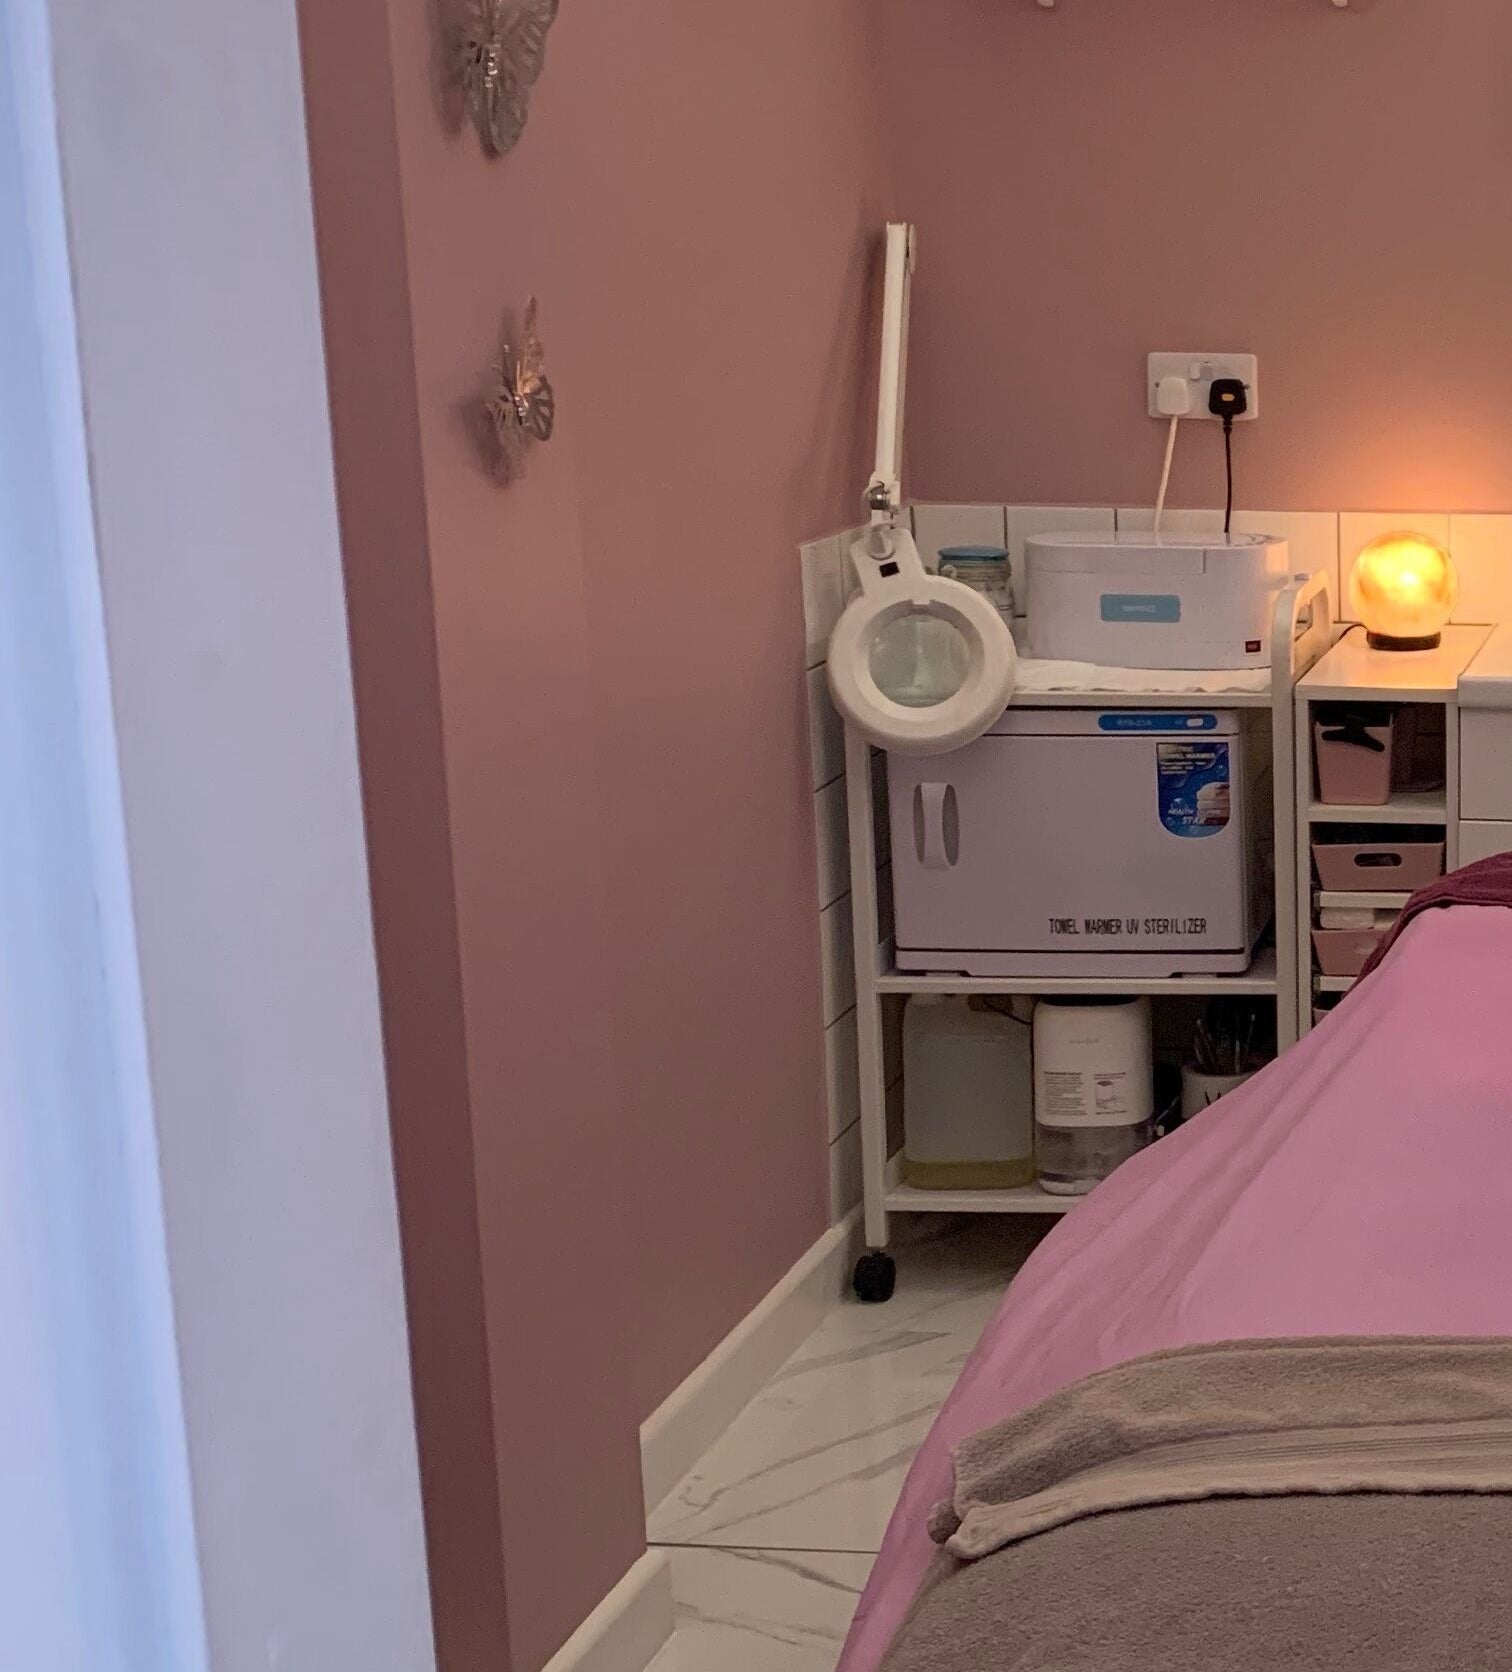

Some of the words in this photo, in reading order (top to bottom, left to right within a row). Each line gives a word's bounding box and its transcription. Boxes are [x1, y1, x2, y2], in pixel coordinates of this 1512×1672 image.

[1049, 918, 1080, 934] TOWEL
[1084, 918, 1122, 934] WARMER
[1126, 918, 1139, 934] UV
[1144, 918, 1207, 934] STERILIZER
